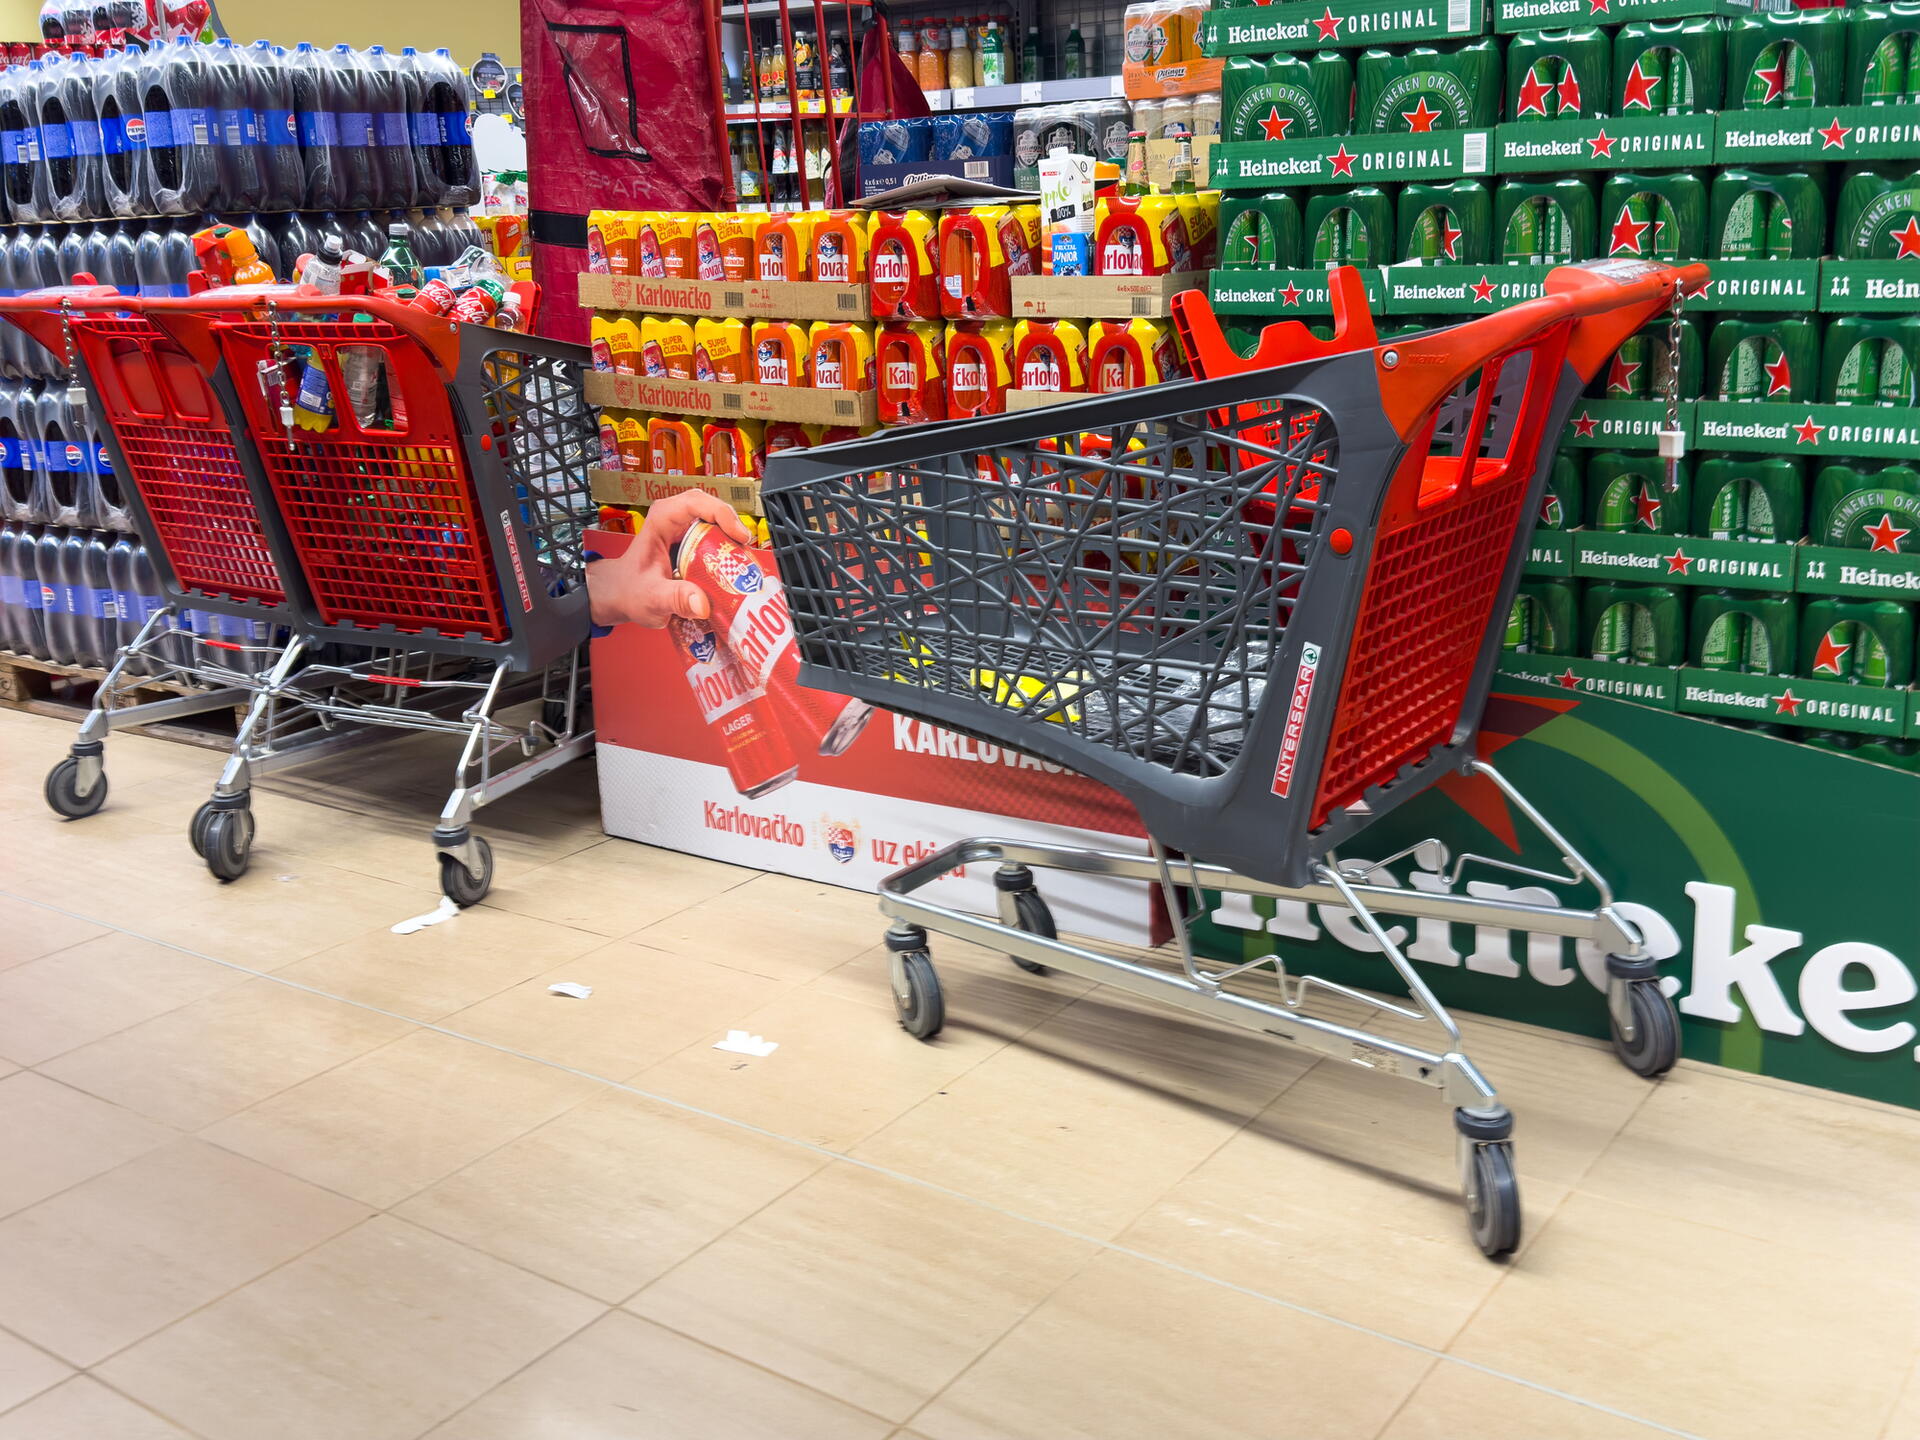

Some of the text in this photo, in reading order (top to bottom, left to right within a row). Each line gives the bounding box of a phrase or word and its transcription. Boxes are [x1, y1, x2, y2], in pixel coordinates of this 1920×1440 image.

[1228, 8, 1437, 44] Heineken ORIGINAL
[1234, 86, 1318, 136] HEINEKEN ORIGINAL
[1376, 75, 1469, 129] HEINEKEN ORIGINAL
[1504, 133, 1705, 158] Heineken ORIGINAL
[1725, 129, 1812, 148] Heineken
[1239, 149, 1452, 178] Heineken ORIGINAL
[1857, 193, 1911, 248] HEINEKEN
[1053, 250, 1078, 263] JUNIOR
[636, 284, 712, 310] Karlovačko
[1394, 284, 1465, 300] Heineken
[1718, 279, 1806, 296] ORIGINAL
[638, 384, 712, 411] Karlovačko
[1703, 421, 1920, 445] Heineken ORIGINAL
[1831, 492, 1885, 538] HEINEKEN
[1581, 550, 1783, 578] Heineken ORIGINAL
[1840, 566, 1920, 589] Heinek
[1586, 678, 1666, 699] ORIGINAL
[1685, 687, 1769, 709] Heineken
[1805, 699, 1896, 723] ORIGINAL
[722, 713, 755, 736] LAGER
[1277, 667, 1313, 782] INTERSPAR
[704, 800, 804, 847] Karlovačko
[872, 838, 898, 865] uz
